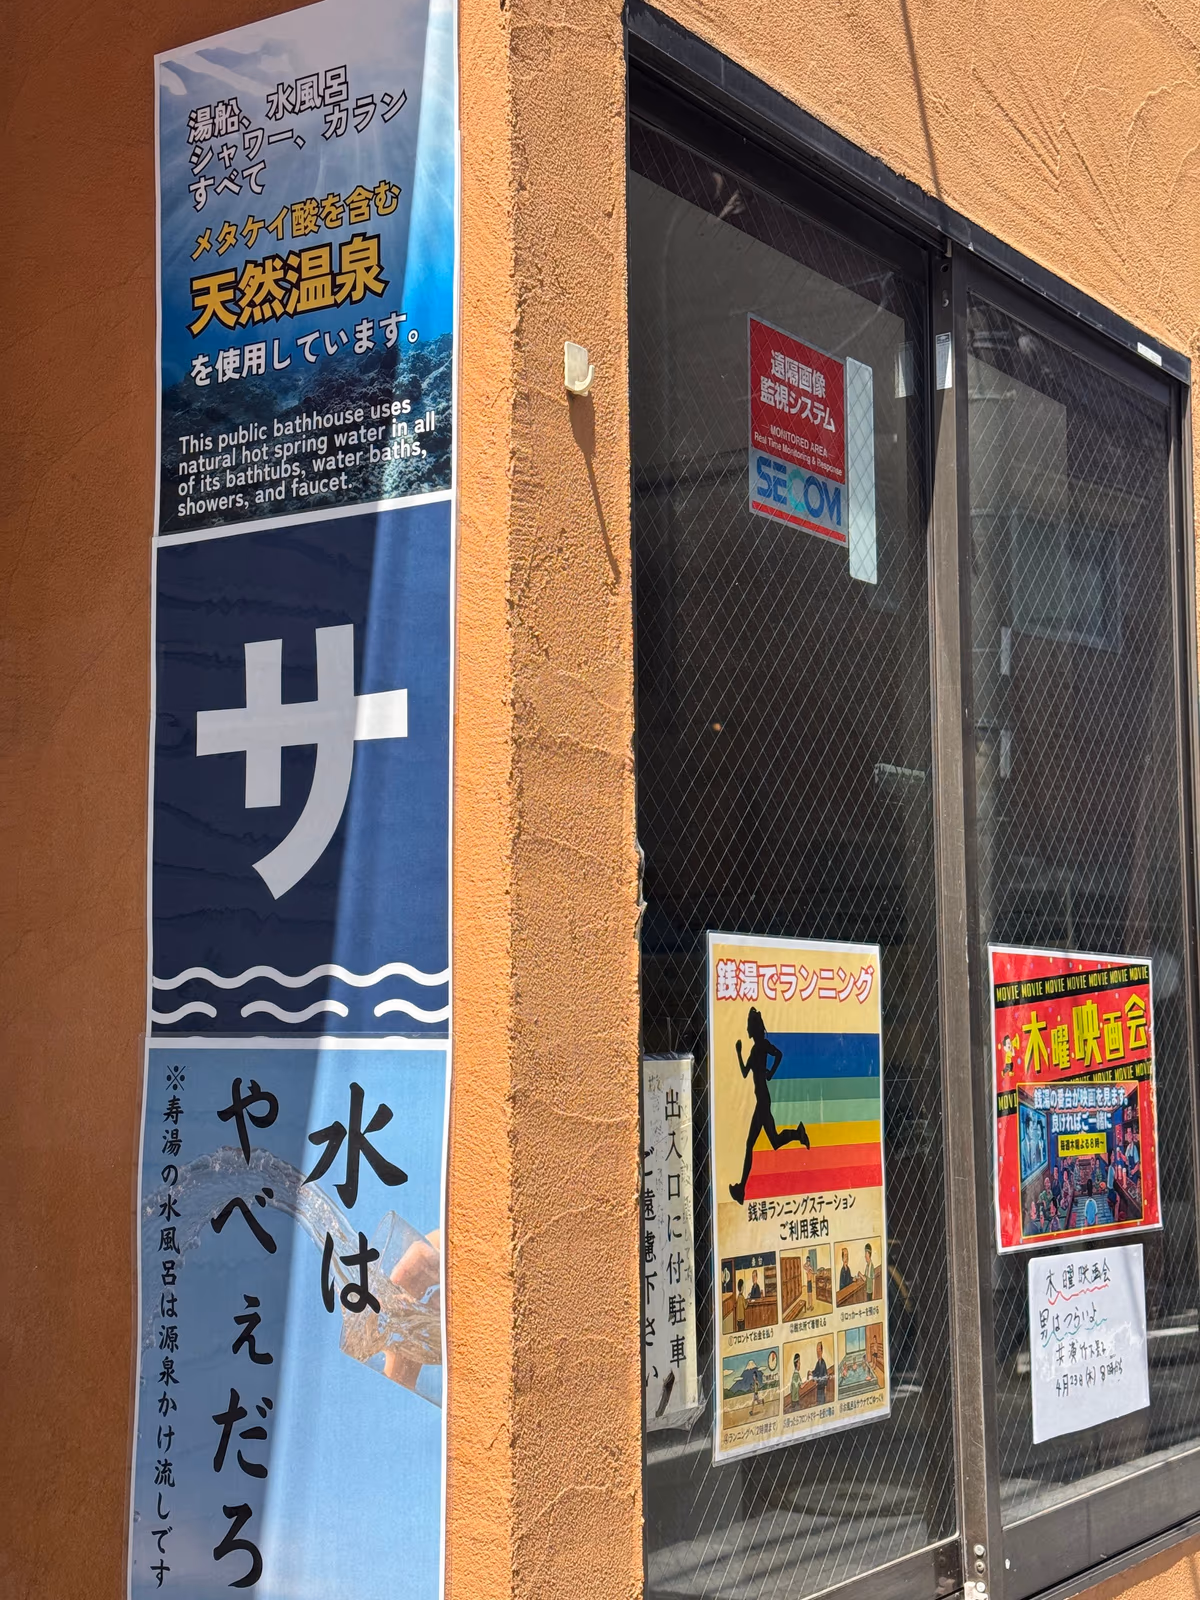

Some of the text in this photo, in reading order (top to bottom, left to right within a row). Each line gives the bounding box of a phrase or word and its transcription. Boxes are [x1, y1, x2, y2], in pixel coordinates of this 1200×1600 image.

[187, 65, 348, 144] 湯船、水風呂
[189, 90, 407, 176] シャワー、カラン
[189, 160, 266, 212] すべて
[191, 180, 401, 262] メタケイ酸を含む
[186, 232, 390, 338] 天然温泉
[190, 311, 419, 387] を使用しています。
[770, 350, 827, 399] 遠隔画像
[178, 399, 411, 455] This public bathhouse uses
[760, 376, 836, 433] 監視システム
[178, 411, 436, 476] natural hot spring water in all
[178, 439, 427, 496] of its bathtubs, water baths,
[754, 431, 767, 445] Real
[767, 436, 782, 451] Time
[782, 443, 811, 466] Monitoring
[817, 458, 843, 476] Response
[770, 424, 828, 458] MONITORED AREA
[177, 474, 353, 517] showers, and faucet.
[756, 456, 842, 526] SECOM
[196, 623, 408, 900] サ
[716, 958, 875, 1004] 銭湯でランニング
[996, 965, 1149, 1002] MOVIE MOVIE MOVIE MOVIE MOVIE MOVIE MOVIE
[1021, 993, 1148, 1073] 木曜映画会
[1115, 1065, 1133, 1080] MOVIE
[301, 1081, 408, 1313] 水は
[747, 1193, 857, 1223] 銭湯ランニングステーション
[665, 1088, 687, 1368] 出入口に付駐車
[779, 1215, 830, 1242] ご利用案内
[1045, 1257, 1111, 1297] 木曜映画会
[150, 1065, 186, 1588] ※寿湯の水風呂は源泉かけ流しです
[1038, 1302, 1097, 1340] 男はつらいよ
